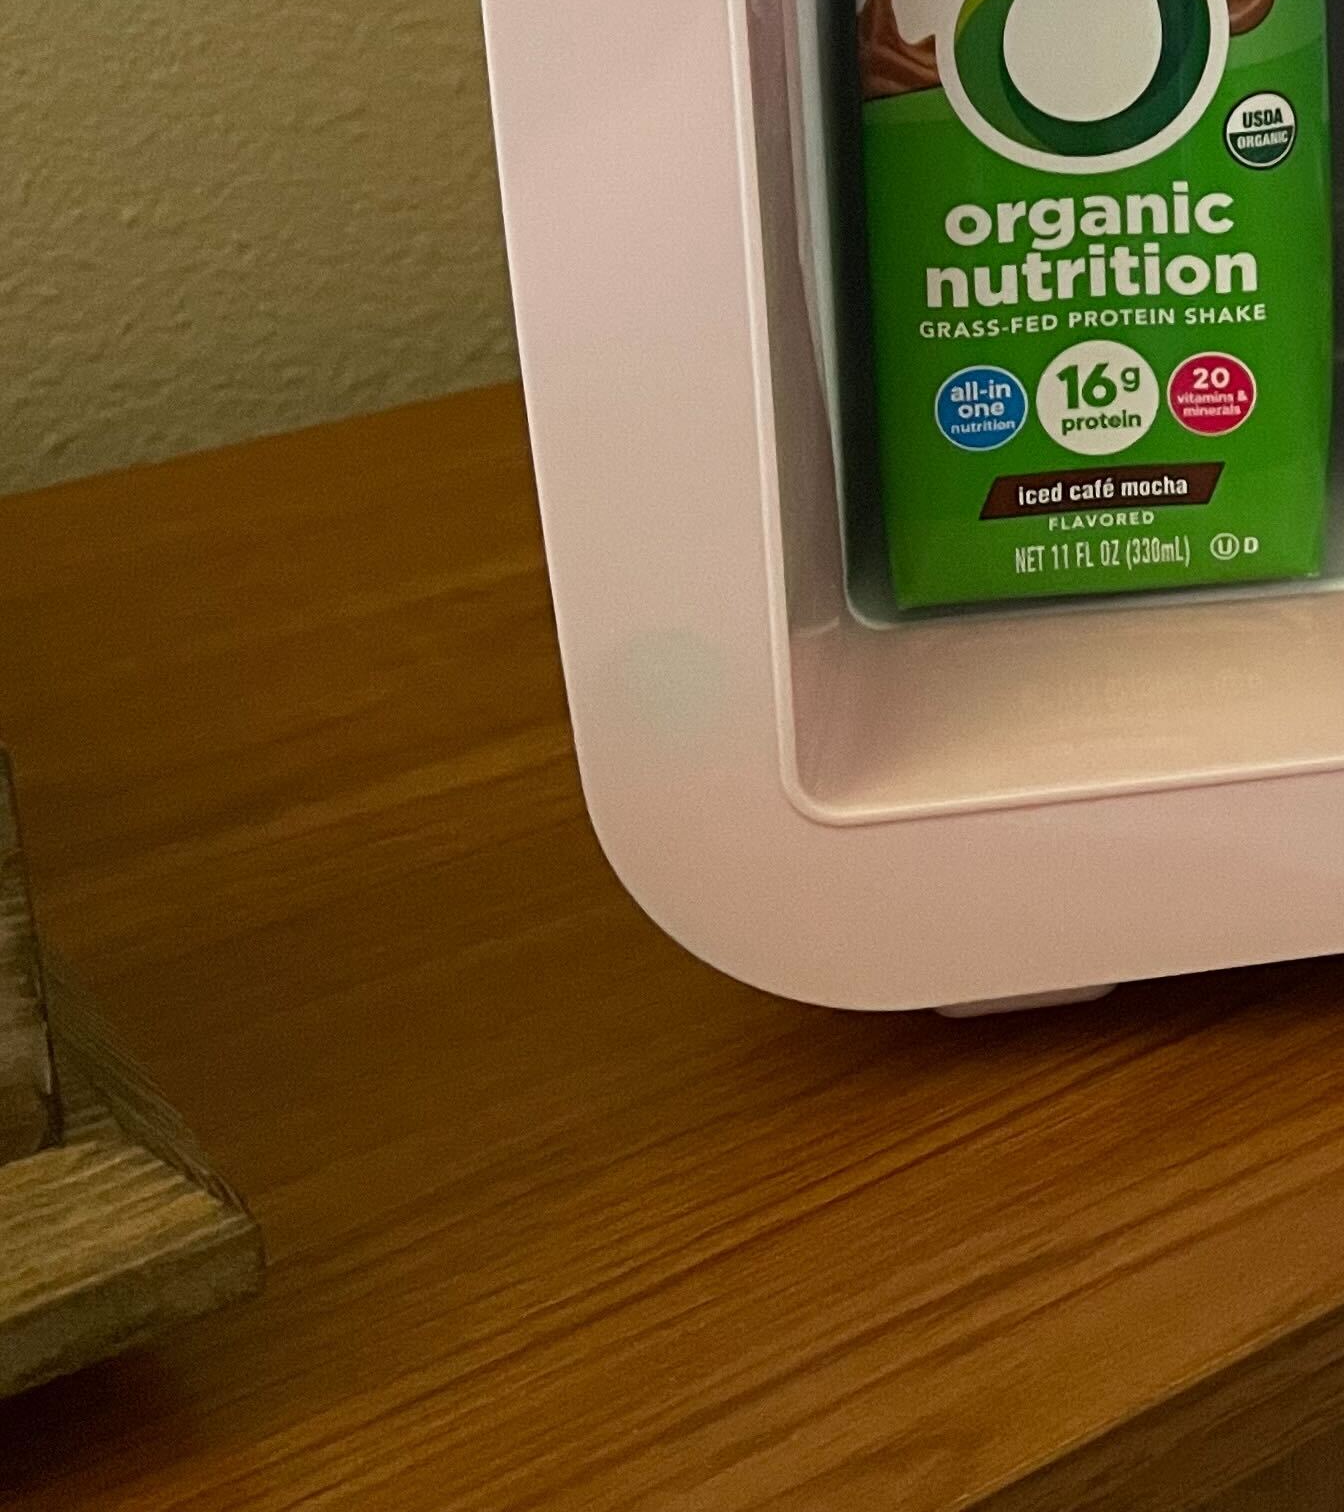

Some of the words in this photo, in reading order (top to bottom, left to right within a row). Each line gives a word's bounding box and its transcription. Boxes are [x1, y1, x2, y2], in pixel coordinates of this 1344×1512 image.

[1242, 108, 1283, 128] USDA
[1237, 131, 1288, 150] ORGANIC
[944, 181, 1234, 251] organic
[926, 243, 1258, 309] nutrition
[919, 315, 1058, 339] GRASS-FED
[1068, 307, 1175, 329] PROTEIN
[1185, 303, 1267, 325] SHAKE
[1192, 368, 1231, 389] 20
[950, 382, 1012, 403] all-in
[1176, 391, 1234, 404] vitamins
[1236, 390, 1248, 402] &
[958, 400, 1005, 418] one
[1183, 403, 1242, 418] minerals
[950, 418, 1016, 435] nutrition
[1061, 409, 1142, 436] protein
[1018, 482, 1062, 506] iced
[1069, 477, 1115, 502] café
[1120, 475, 1188, 498] mocha
[1049, 511, 1154, 532] FLAVORED
[1015, 545, 1045, 574] NET
[1051, 543, 1068, 570] 11
[1078, 541, 1094, 569] FL
[1100, 539, 1119, 566] OZ
[1126, 535, 1190, 569] (330mL)
